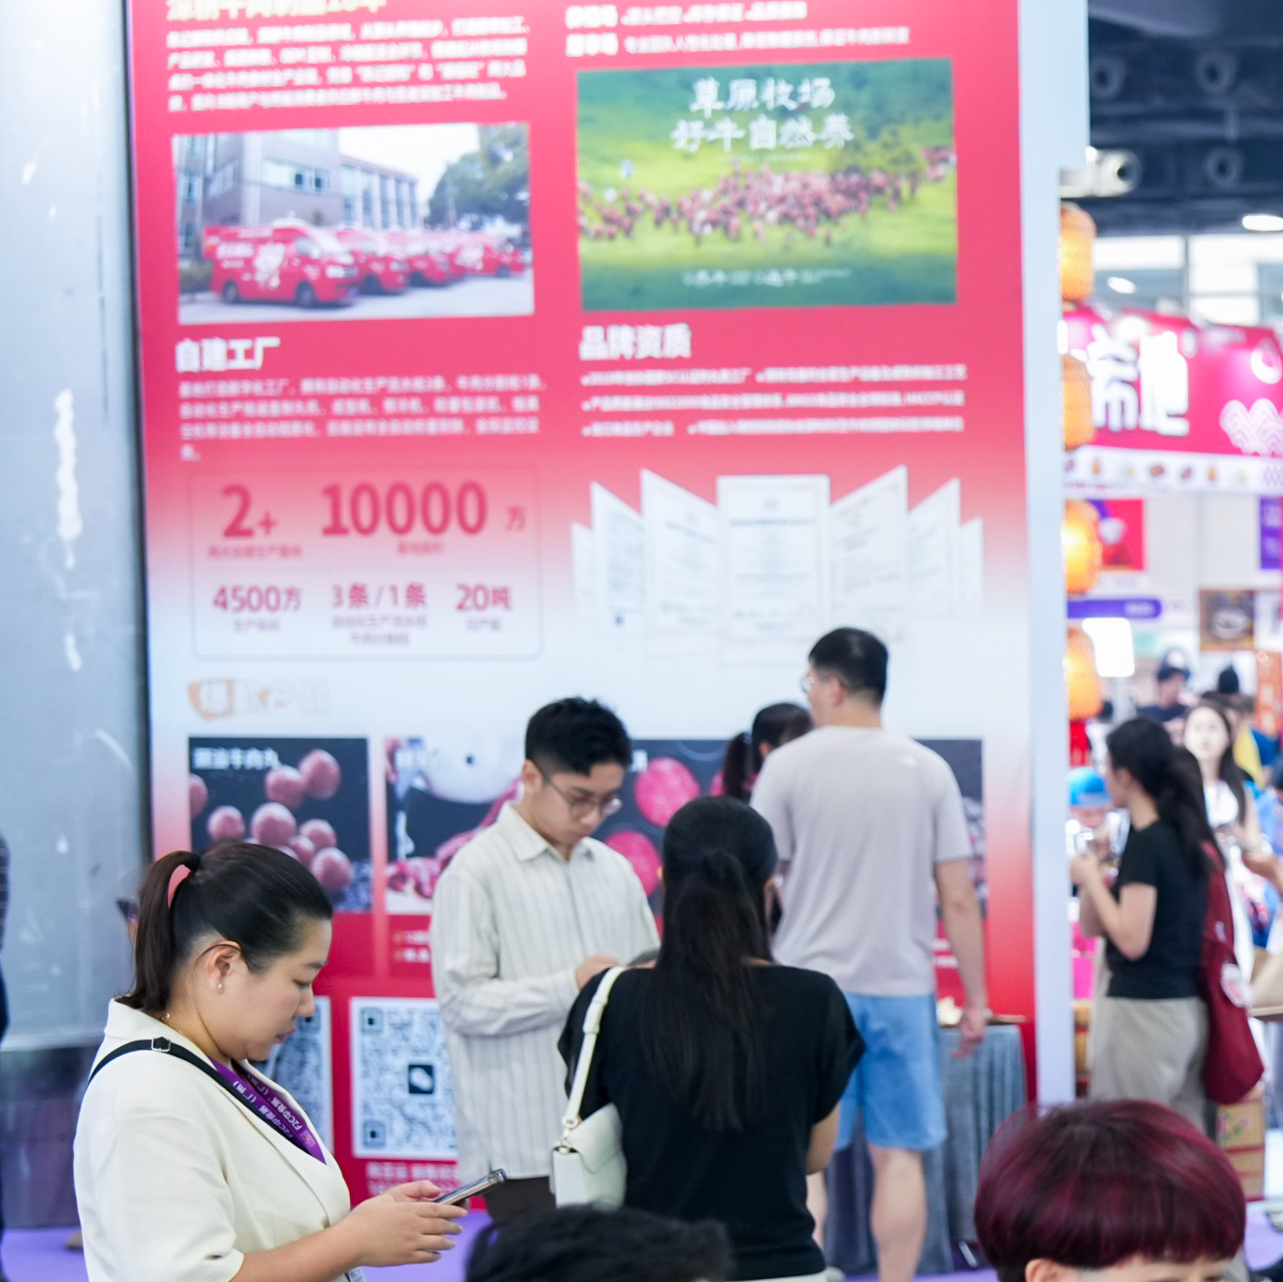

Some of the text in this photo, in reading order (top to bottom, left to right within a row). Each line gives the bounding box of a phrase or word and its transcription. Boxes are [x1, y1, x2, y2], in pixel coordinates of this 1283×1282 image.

[690, 77, 835, 117] 草原牧场
[671, 113, 854, 152] 好牛自然养
[176, 336, 280, 372] 自建工厂
[580, 323, 691, 360] 品牌资质
[222, 482, 278, 539] 2+
